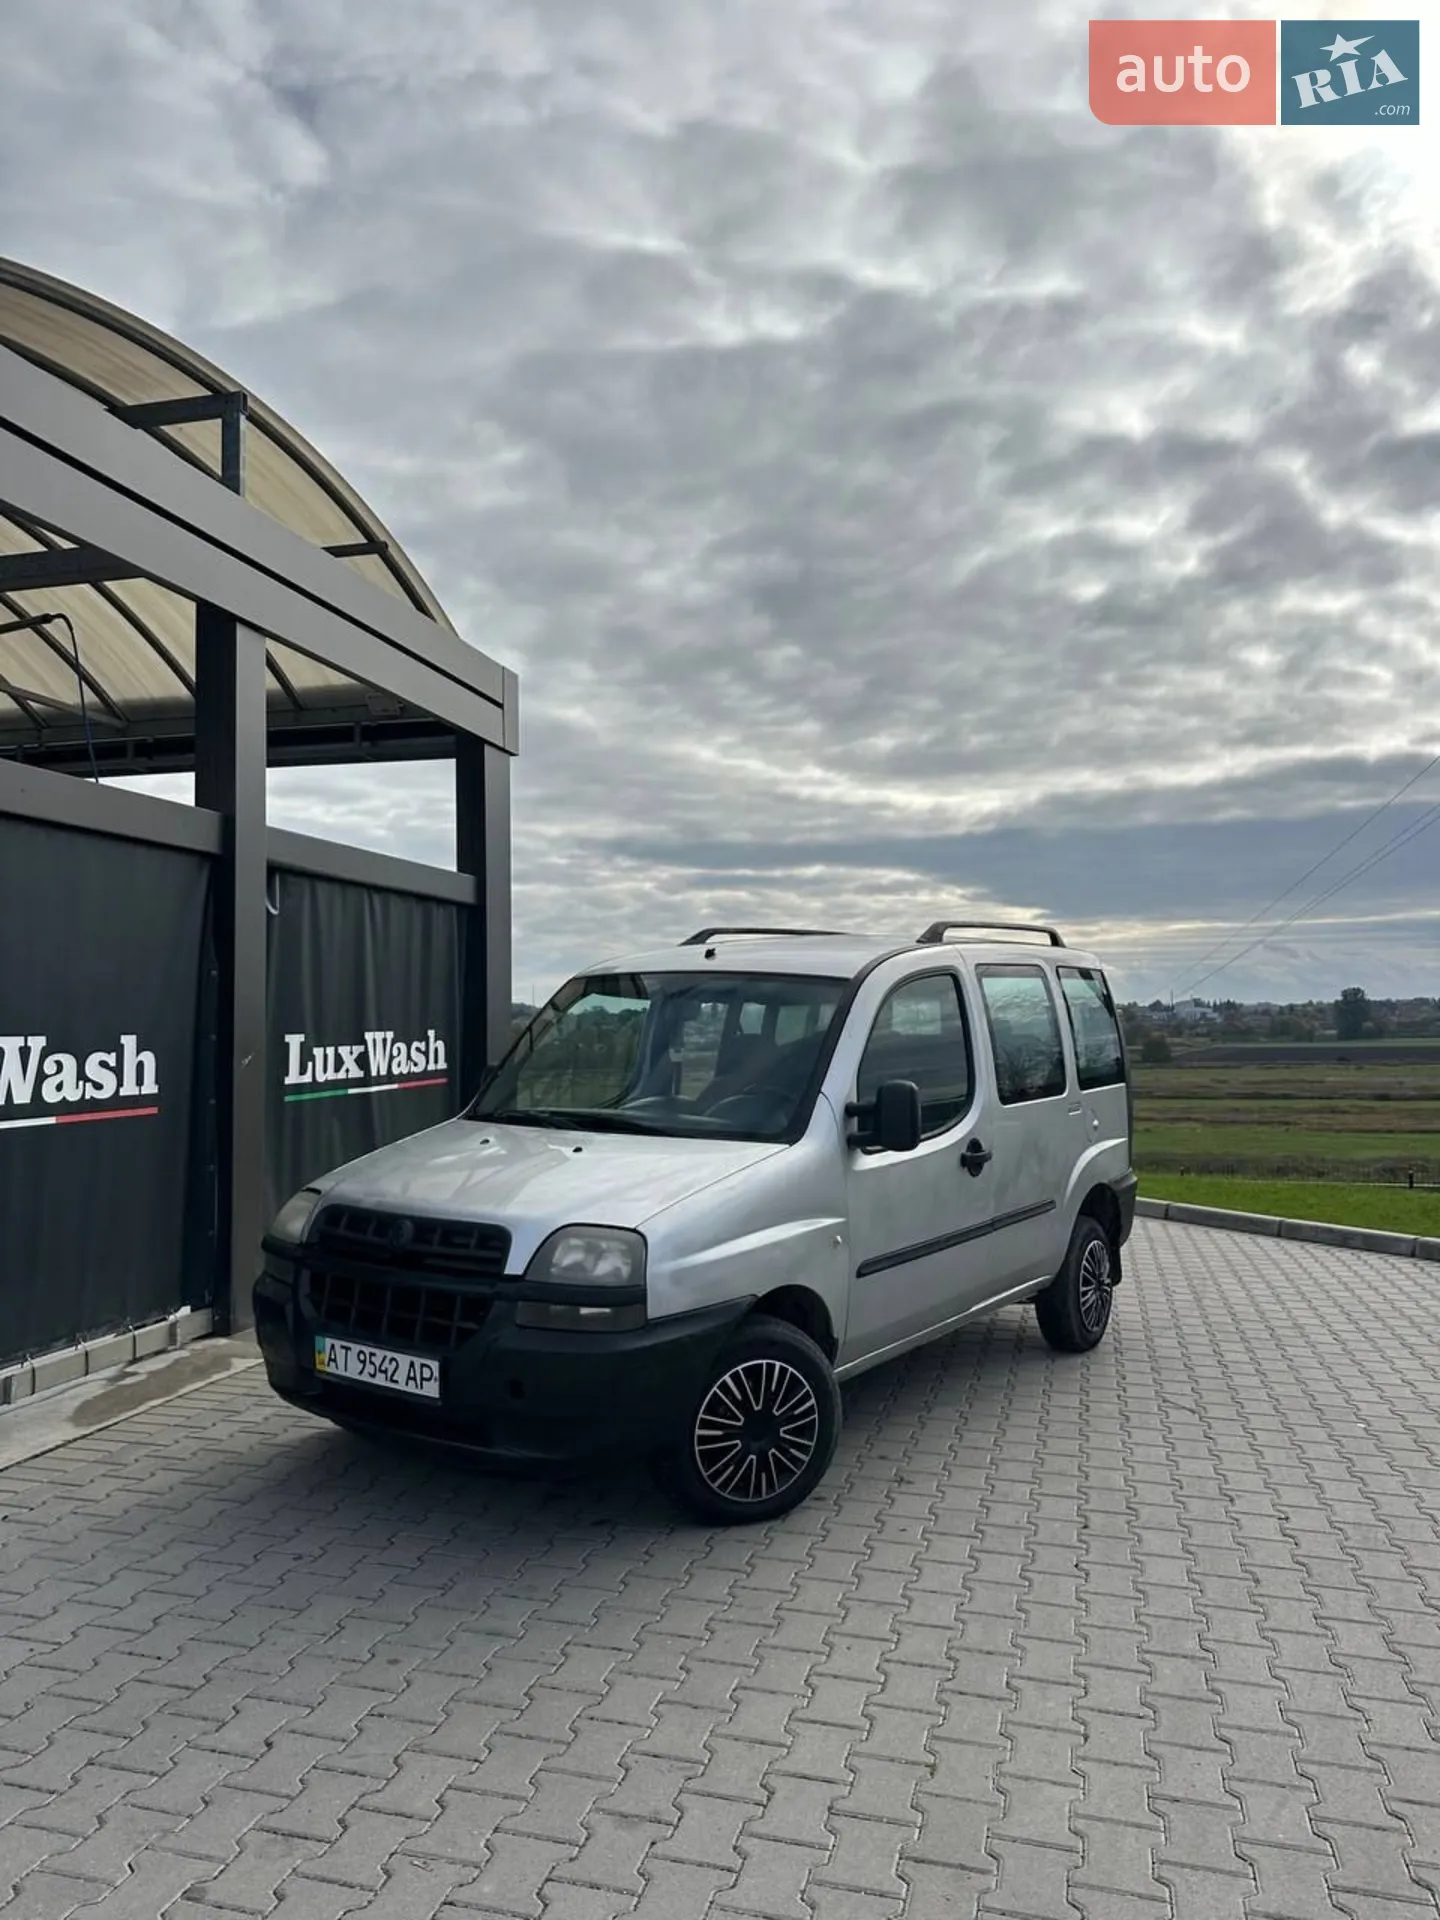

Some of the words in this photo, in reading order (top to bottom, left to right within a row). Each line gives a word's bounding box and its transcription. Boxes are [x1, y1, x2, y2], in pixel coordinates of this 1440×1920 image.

[326, 1343, 352, 1373] AT
[356, 1349, 400, 1384] 9542
[405, 1359, 435, 1390] AP
